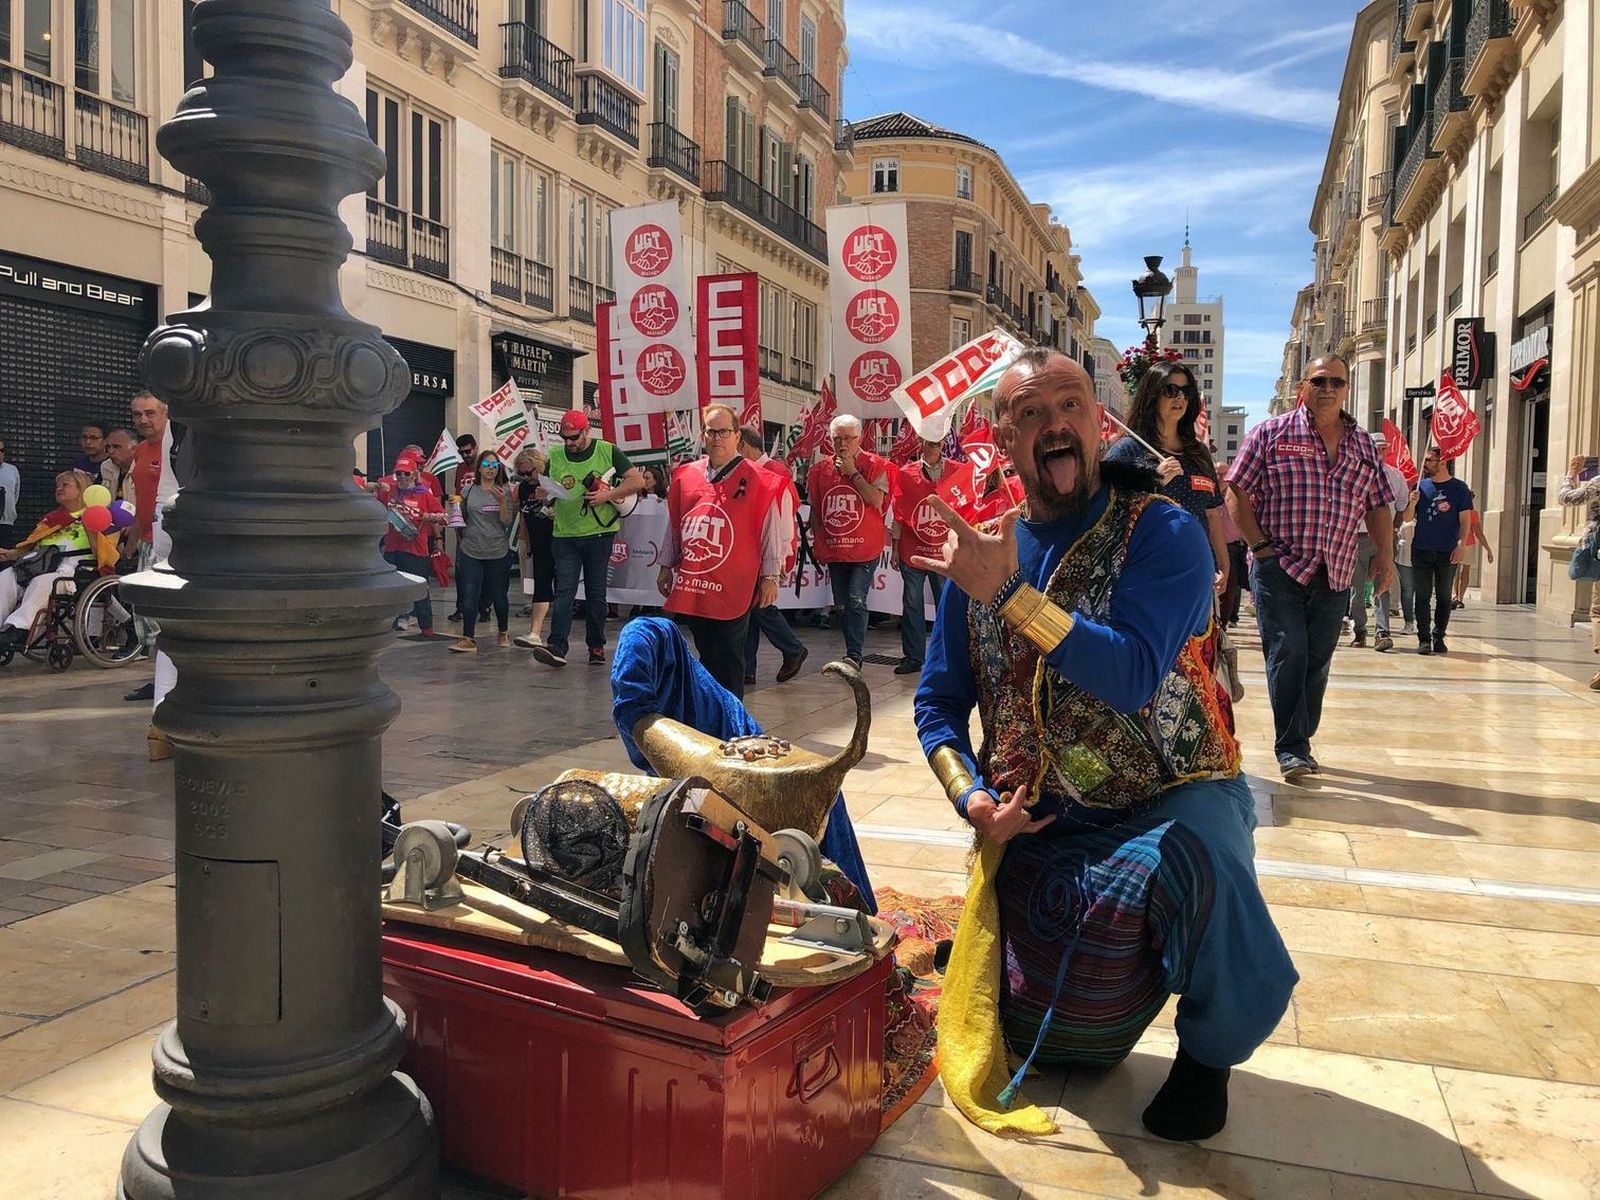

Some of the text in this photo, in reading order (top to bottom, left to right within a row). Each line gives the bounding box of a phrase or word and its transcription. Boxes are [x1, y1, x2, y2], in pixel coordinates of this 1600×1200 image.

[635, 231, 660, 253] UGT
[854, 233, 884, 255] UGT
[0, 265, 143, 305] Pull and Bear
[639, 291, 666, 311] UGT
[857, 297, 886, 317] UGT
[512, 341, 549, 361] RAFAEL
[646, 351, 673, 370] UGT
[1455, 321, 1471, 387] PRIMOR
[860, 358, 889, 377] UGT
[413, 372, 448, 390] ERSA
[537, 420, 561, 434] TISSO
[496, 425, 530, 460] CCO
[1278, 444, 1308, 452] CCOO
[827, 494, 857, 515] UGT
[918, 505, 943, 523] UG
[681, 515, 725, 546] UGT
[841, 536, 865, 545] mano
[691, 578, 723, 592] mano
